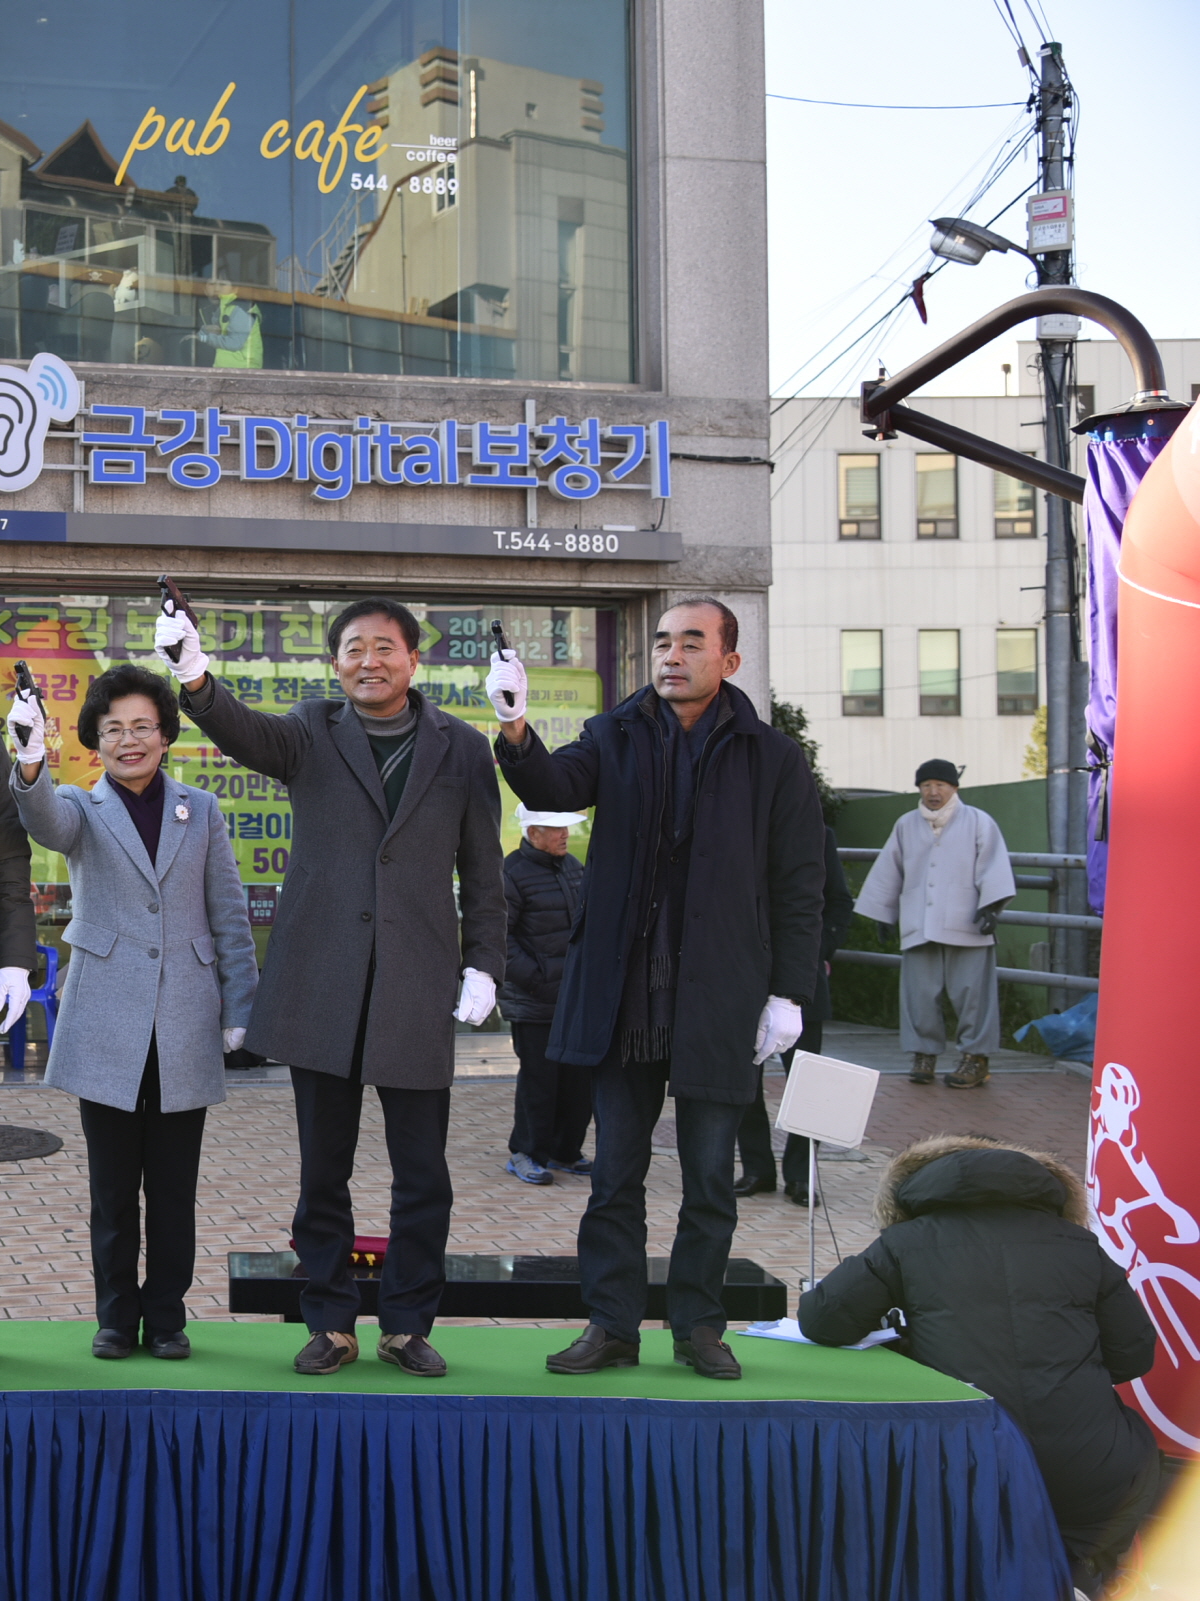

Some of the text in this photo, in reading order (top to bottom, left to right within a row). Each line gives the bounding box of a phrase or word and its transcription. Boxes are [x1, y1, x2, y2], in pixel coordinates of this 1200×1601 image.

[114, 81, 388, 193] pub cafe
[429, 134, 458, 147] beer
[406, 150, 458, 163] coffee
[492, 530, 619, 553] T.544-8880
